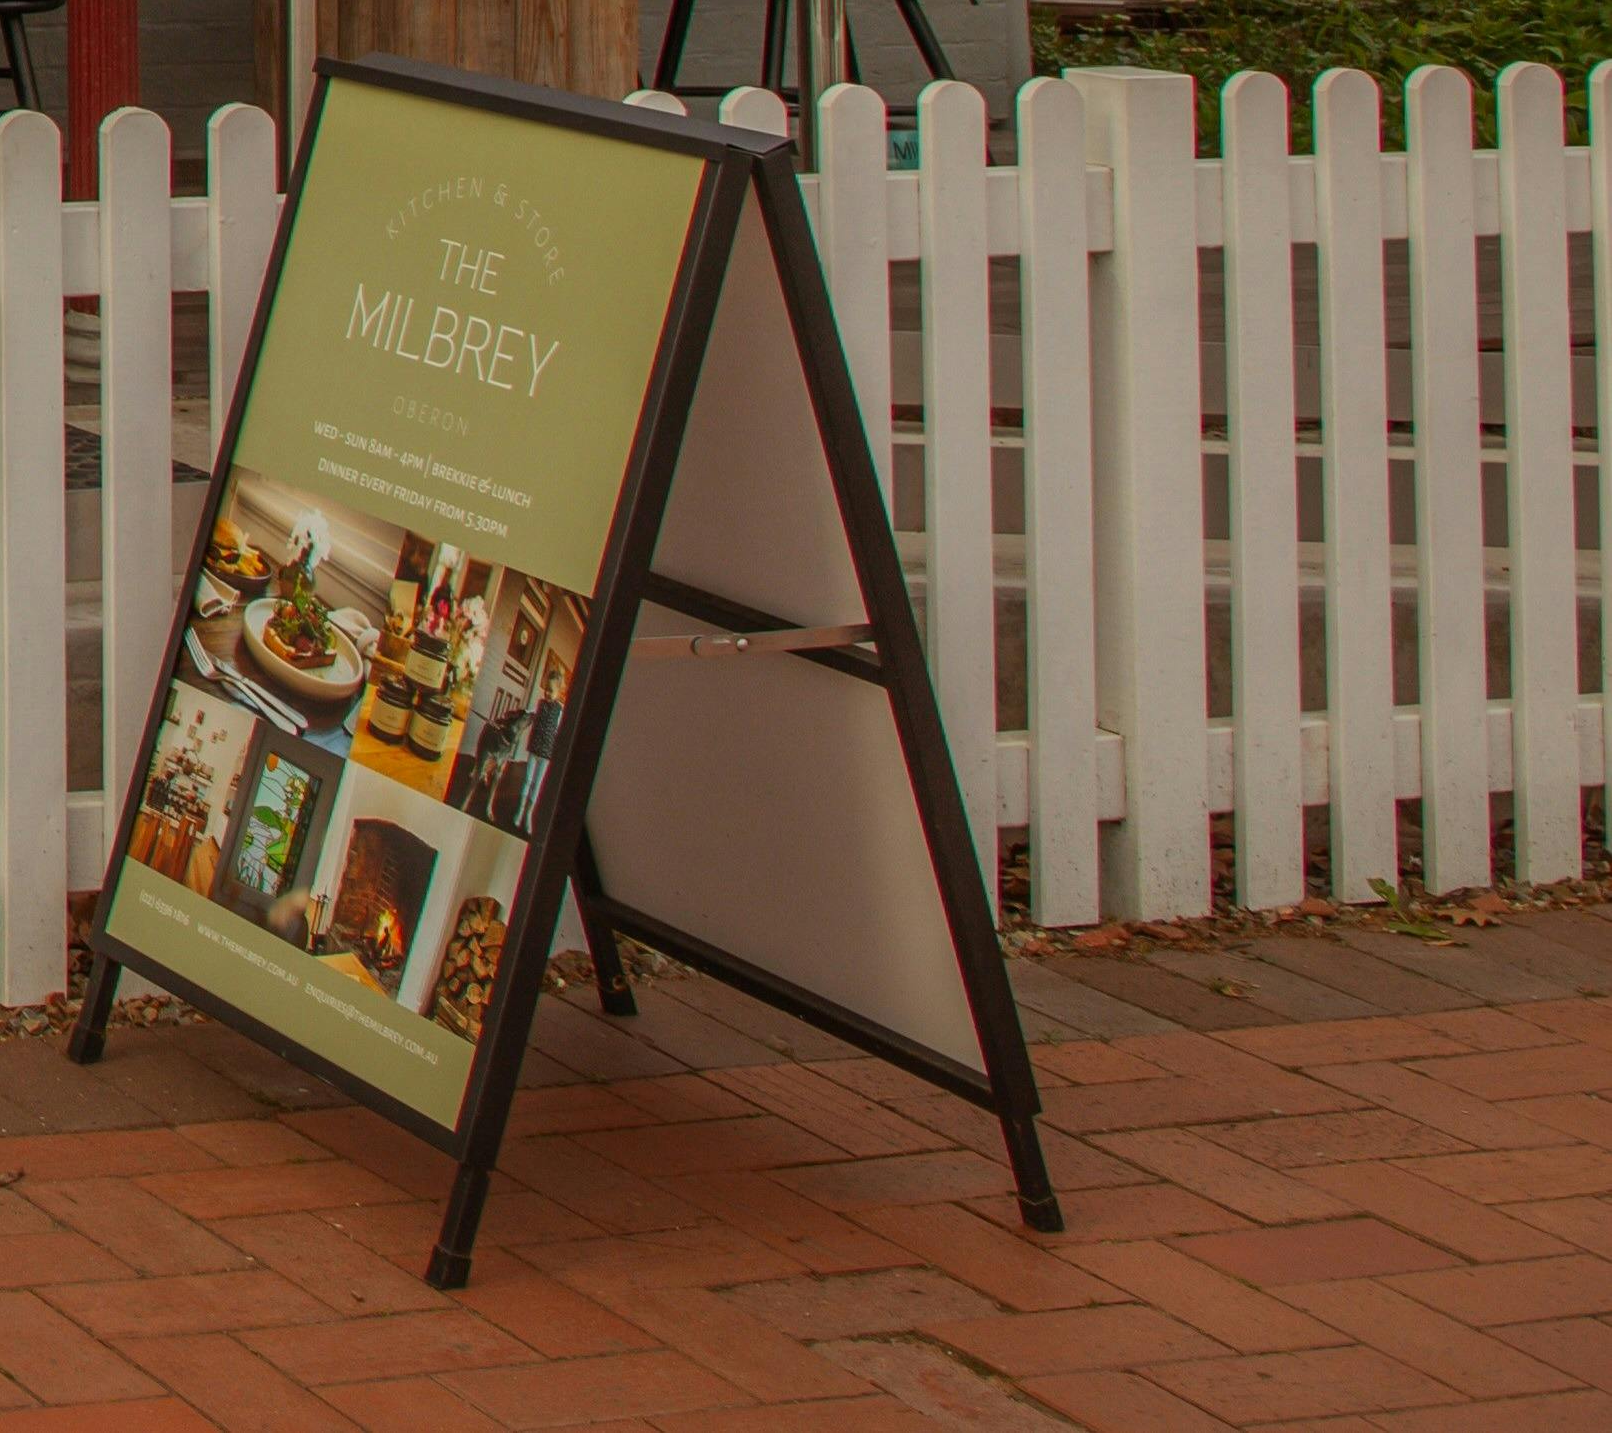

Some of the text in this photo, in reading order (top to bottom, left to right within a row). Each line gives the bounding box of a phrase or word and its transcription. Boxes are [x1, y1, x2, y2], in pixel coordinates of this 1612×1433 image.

[385, 176, 565, 286] KITCHEN & STORE
[439, 238, 506, 295] THE
[345, 283, 561, 398] MILBREY
[390, 394, 469, 437] OBERON
[313, 420, 338, 440] WED
[344, 431, 367, 451] SUN
[368, 438, 392, 459] 8AM
[399, 451, 424, 471] 4PM
[431, 462, 479, 490] BREKKIE
[491, 483, 532, 508] LUNCH
[317, 456, 359, 485] DINNER
[359, 472, 395, 496] EVERY
[393, 484, 432, 510] FRIDAY
[433, 499, 465, 523] FROM
